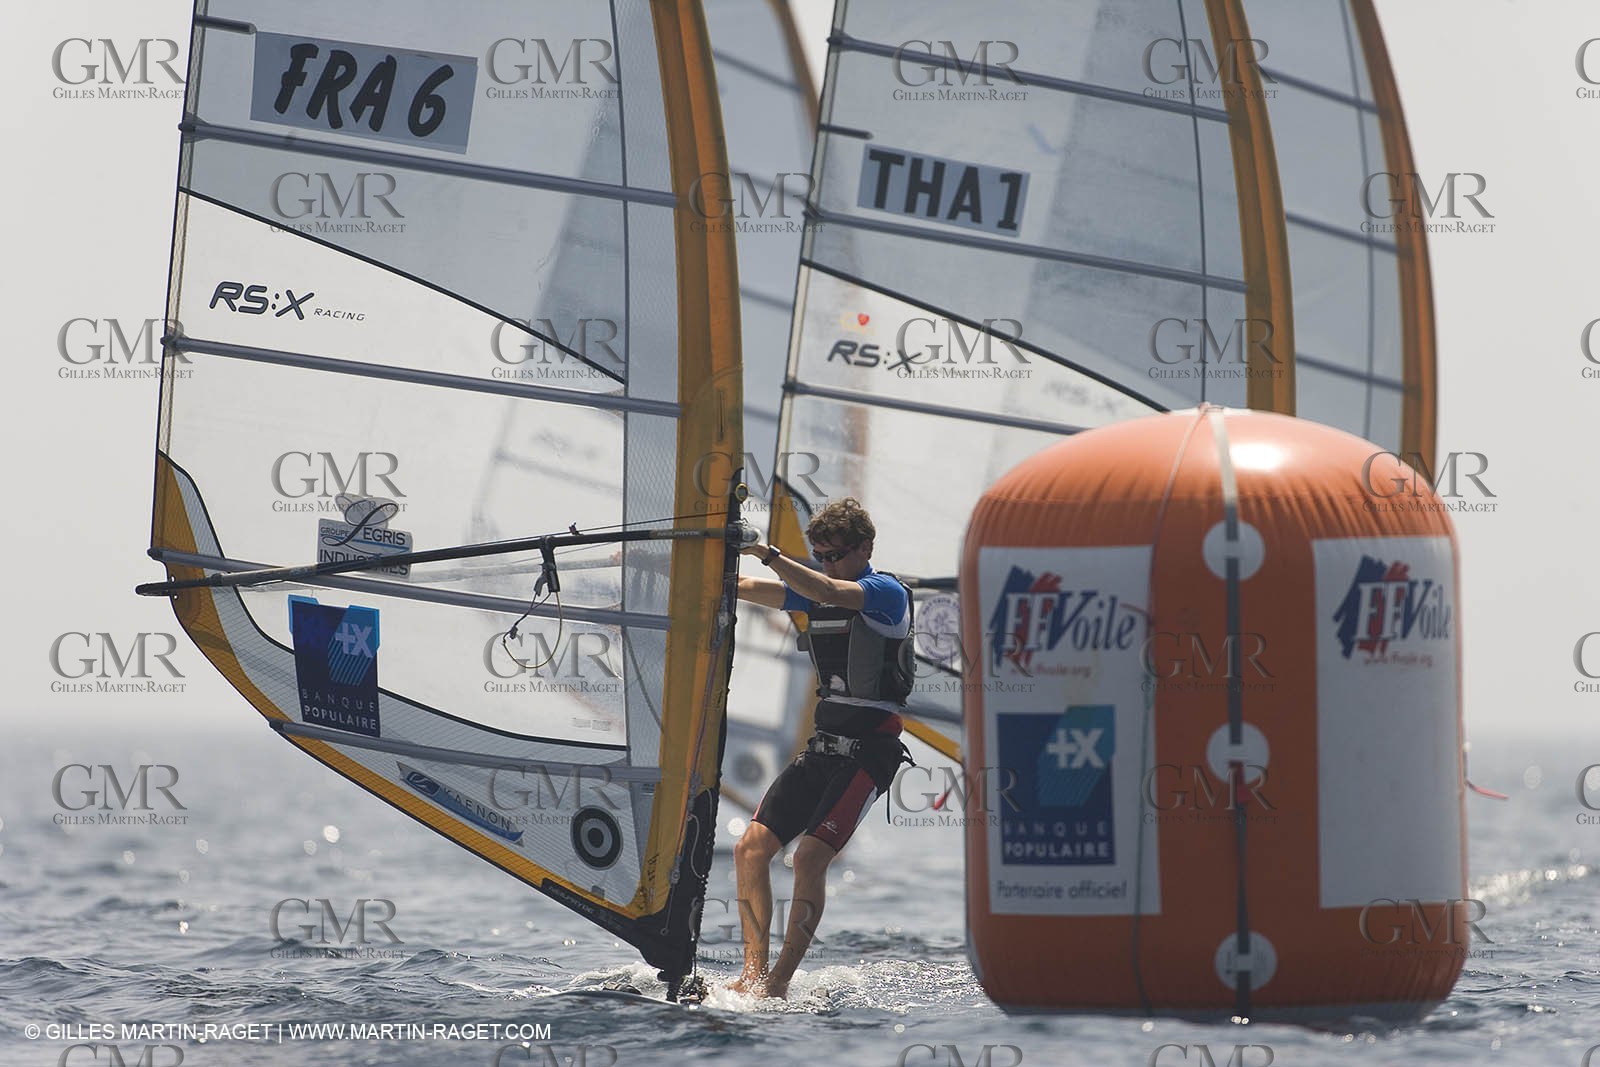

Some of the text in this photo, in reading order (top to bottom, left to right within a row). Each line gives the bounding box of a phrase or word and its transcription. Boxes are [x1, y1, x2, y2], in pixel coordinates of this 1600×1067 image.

[274, 43, 454, 137] FRA 6
[869, 149, 1023, 231] THA 1
[209, 281, 365, 321] RS:X RACING
[827, 340, 922, 373] RS:X
[302, 688, 375, 712] BANQUE
[304, 705, 376, 730] POPULAIRE
[1003, 821, 1108, 837] BANQUE
[1004, 840, 1110, 858] POPULAIRE
